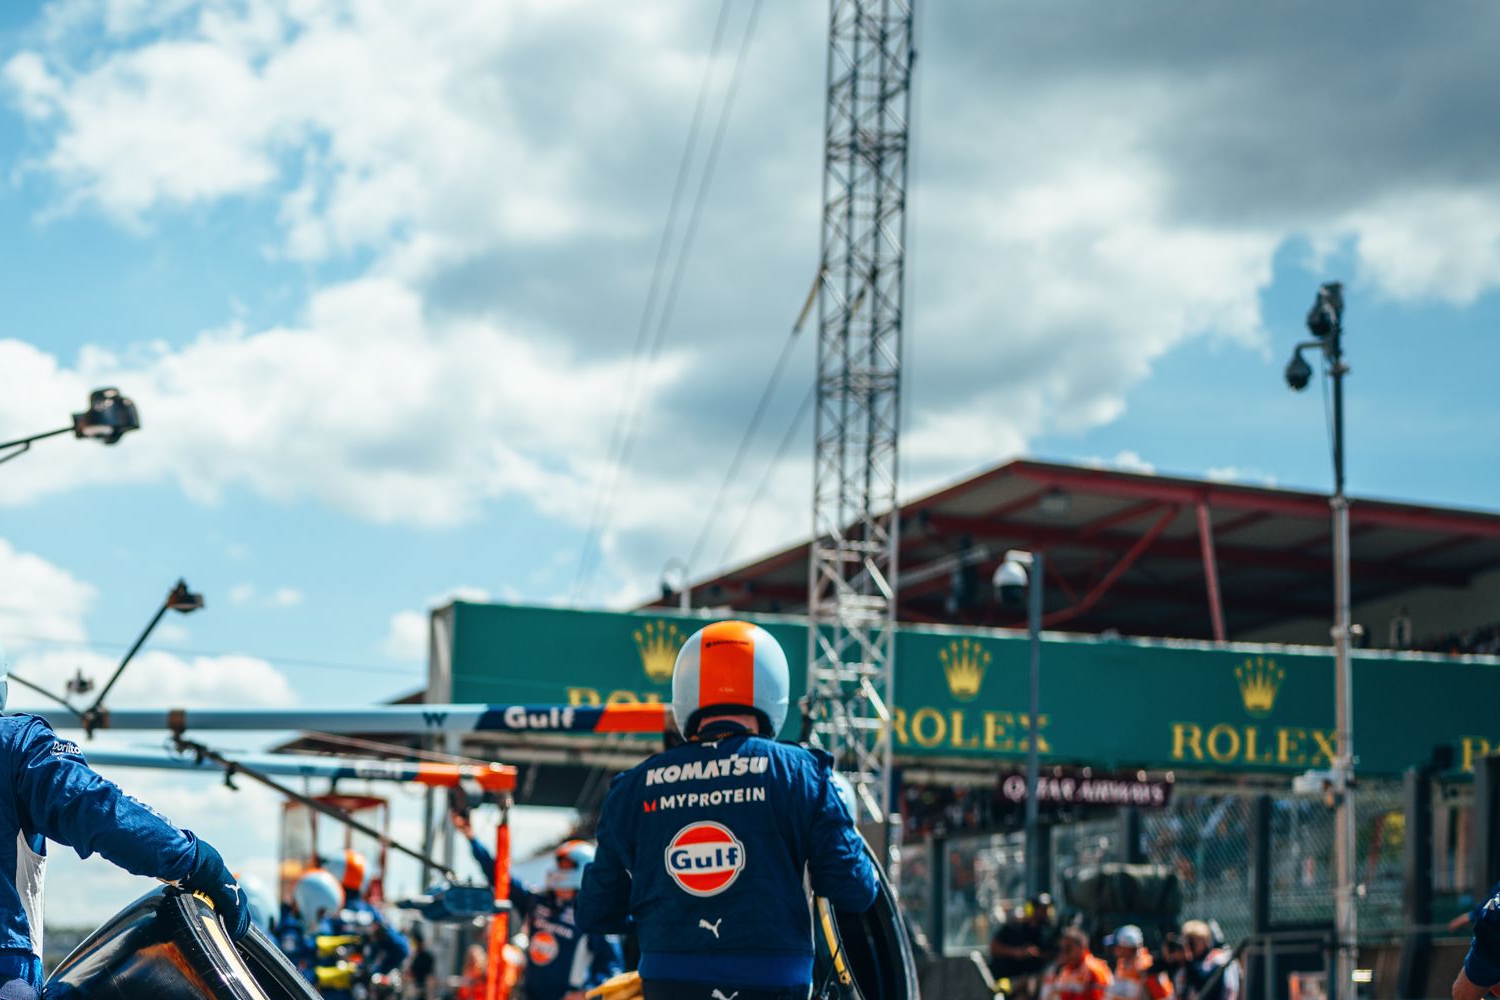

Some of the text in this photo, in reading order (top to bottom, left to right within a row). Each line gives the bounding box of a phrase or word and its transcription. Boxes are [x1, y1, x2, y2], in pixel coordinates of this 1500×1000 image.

[504, 706, 575, 728] Gulf
[876, 707, 1051, 753] ROLEX
[1172, 723, 1338, 765] ROLEX
[646, 754, 768, 786] KOMATSU
[660, 787, 766, 810] MYPROTEIN
[670, 847, 739, 870] Gulf
